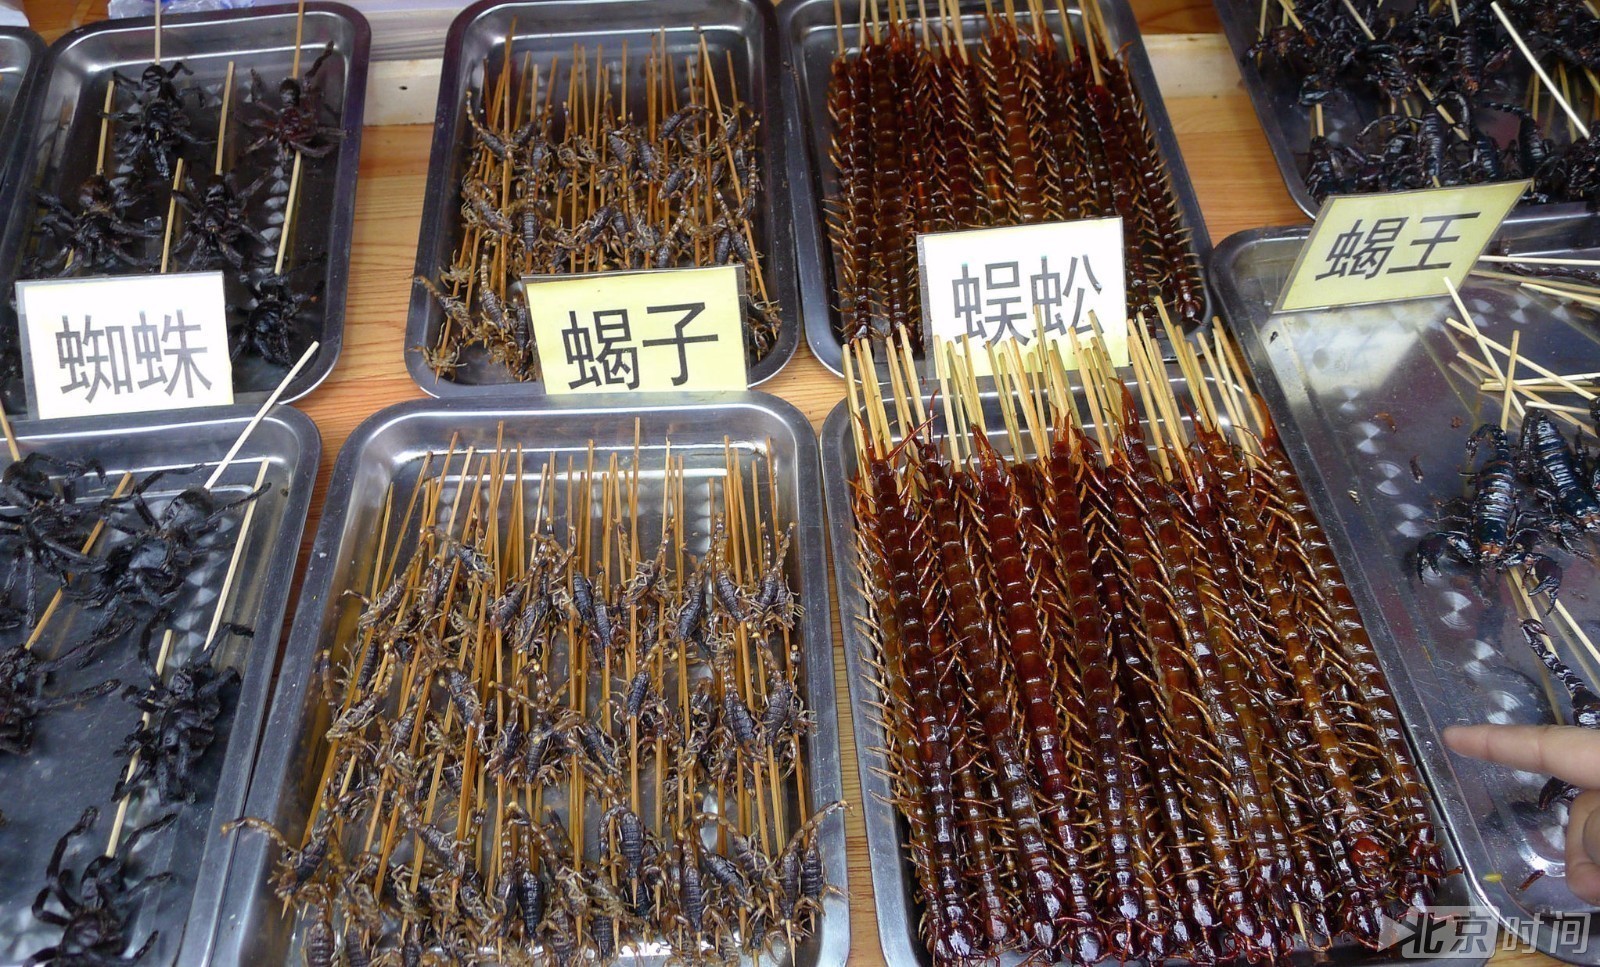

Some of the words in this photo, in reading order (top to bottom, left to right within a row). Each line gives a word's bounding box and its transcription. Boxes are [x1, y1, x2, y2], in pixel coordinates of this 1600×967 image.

[1315, 212, 1481, 281] 蝎王
[561, 302, 719, 391] 蝎子
[951, 254, 1104, 349] 蜈蚣
[55, 309, 213, 403] 蜘蛛
